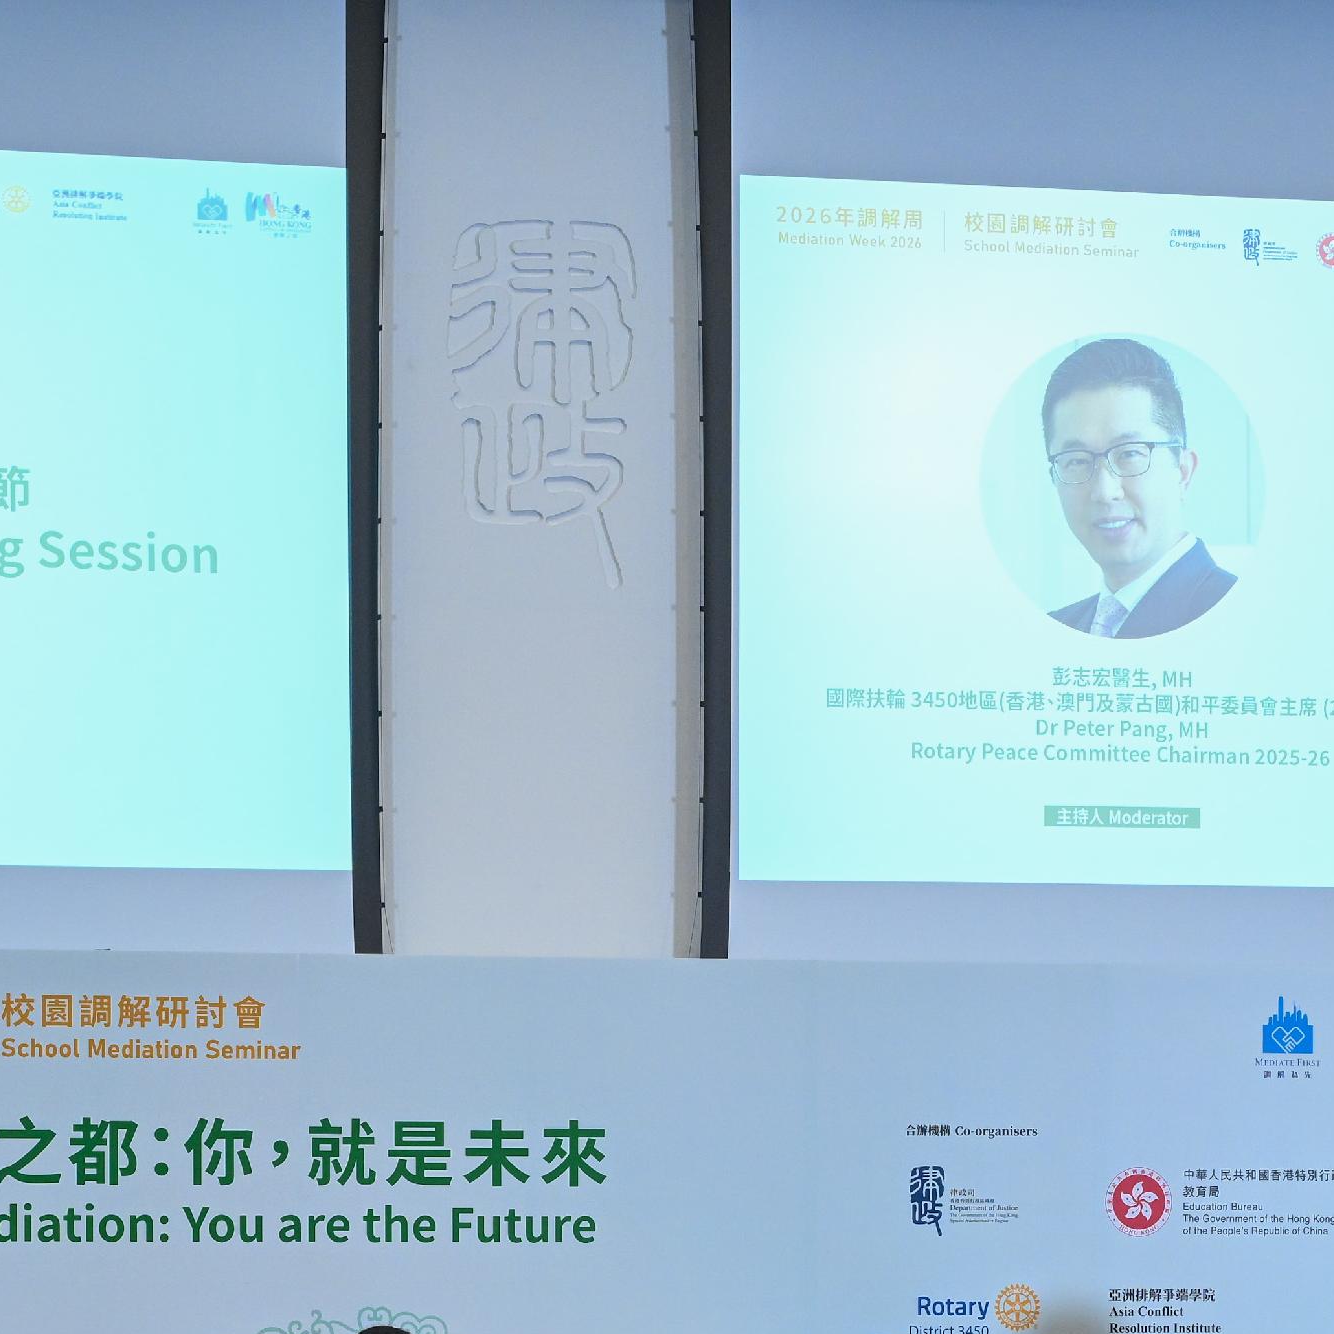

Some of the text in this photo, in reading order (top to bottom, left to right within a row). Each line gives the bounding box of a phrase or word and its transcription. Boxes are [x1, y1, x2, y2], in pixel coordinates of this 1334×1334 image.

[777, 206, 922, 230] 2026年調解周
[965, 212, 1117, 238] 校園調解研討會
[779, 232, 921, 248] Mediation Week 2026
[965, 240, 1139, 257] School Mediation Seminar
[39, 531, 217, 573] Session
[1053, 666, 1191, 690] 彭志宏醫生, MH
[827, 688, 905, 709] 國際扶輪
[1037, 720, 1207, 742] Dr Peter Pang, MH
[912, 742, 1330, 766] Rotary Peace Committee Chairman 2025-26
[1056, 808, 1189, 826] 主持人 Moderator
[2, 993, 265, 1030] 校園調解研討會
[2, 1038, 301, 1060] School Mediation Seminar
[955, 1125, 1038, 1139] Co-organisers
[1182, 1185, 1219, 1198] 教育局
[1183, 1202, 1263, 1211] Education Bureau
[182, 1207, 263, 1243] You
[279, 1215, 349, 1242] are
[363, 1205, 435, 1243] the
[452, 1208, 595, 1243] Future
[1183, 1214, 1200, 1223] The
[1203, 1214, 1257, 1223] Government
[1271, 1214, 1284, 1222] the
[1288, 1214, 1310, 1225] Hong
[1183, 1227, 1328, 1237] of the People's Republic of China
[917, 1296, 989, 1320] Rotary
[1109, 1306, 1184, 1317] Asia Conflict
[1109, 1323, 1222, 1334] Resolution Institute
